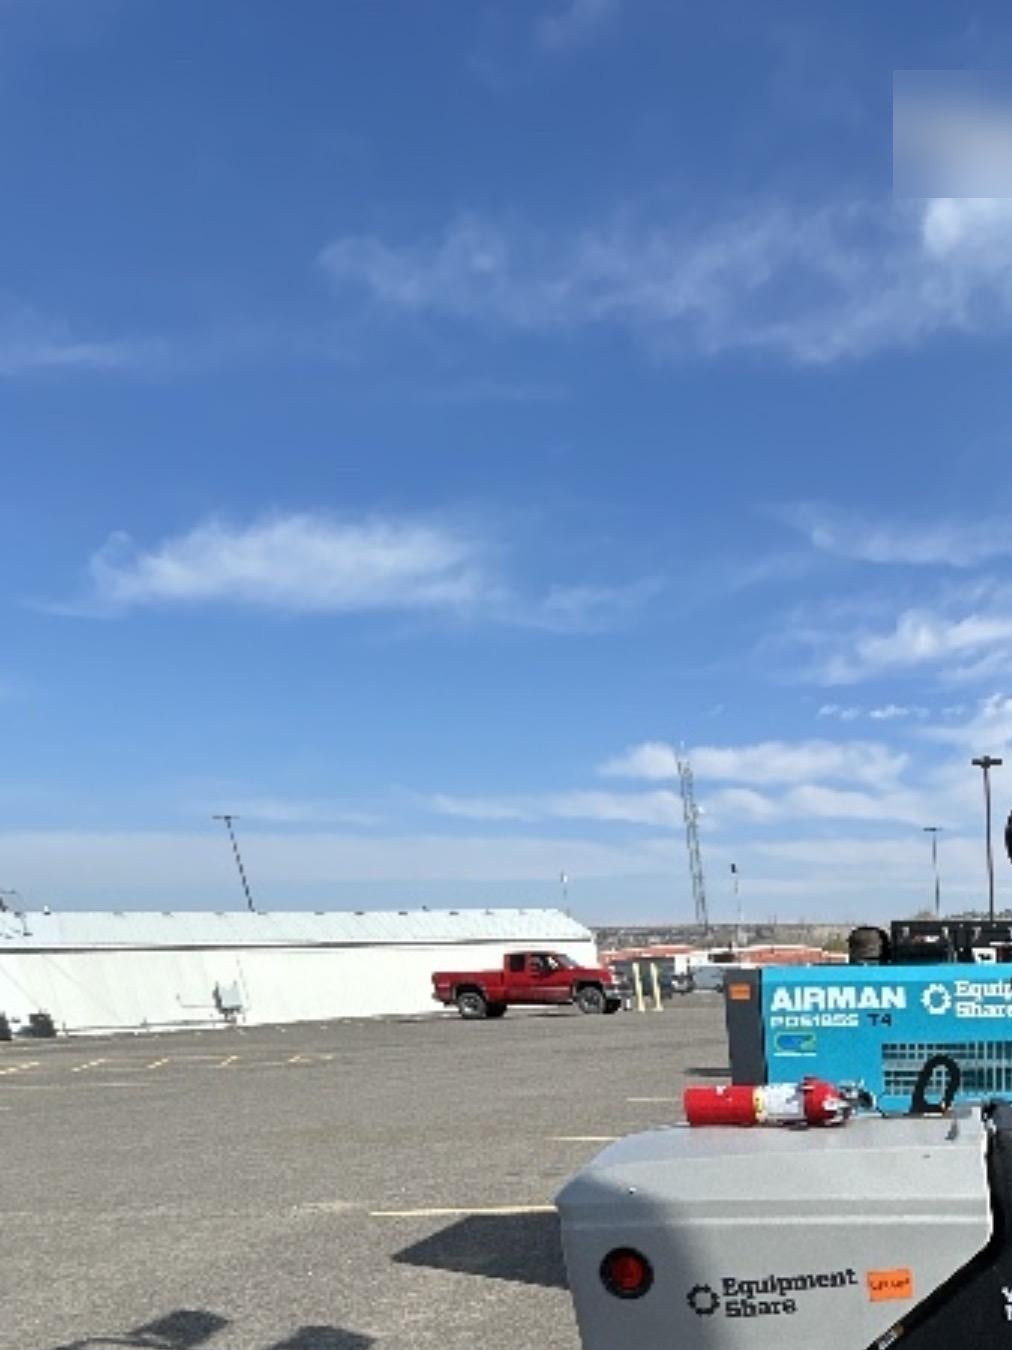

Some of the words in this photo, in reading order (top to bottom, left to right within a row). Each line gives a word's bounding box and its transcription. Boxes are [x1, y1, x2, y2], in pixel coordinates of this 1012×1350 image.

[770, 987, 907, 1011] AIRMAN
[867, 1013, 892, 1027] T4
[722, 1269, 858, 1299] Equipment
[725, 1299, 797, 1317] Share
